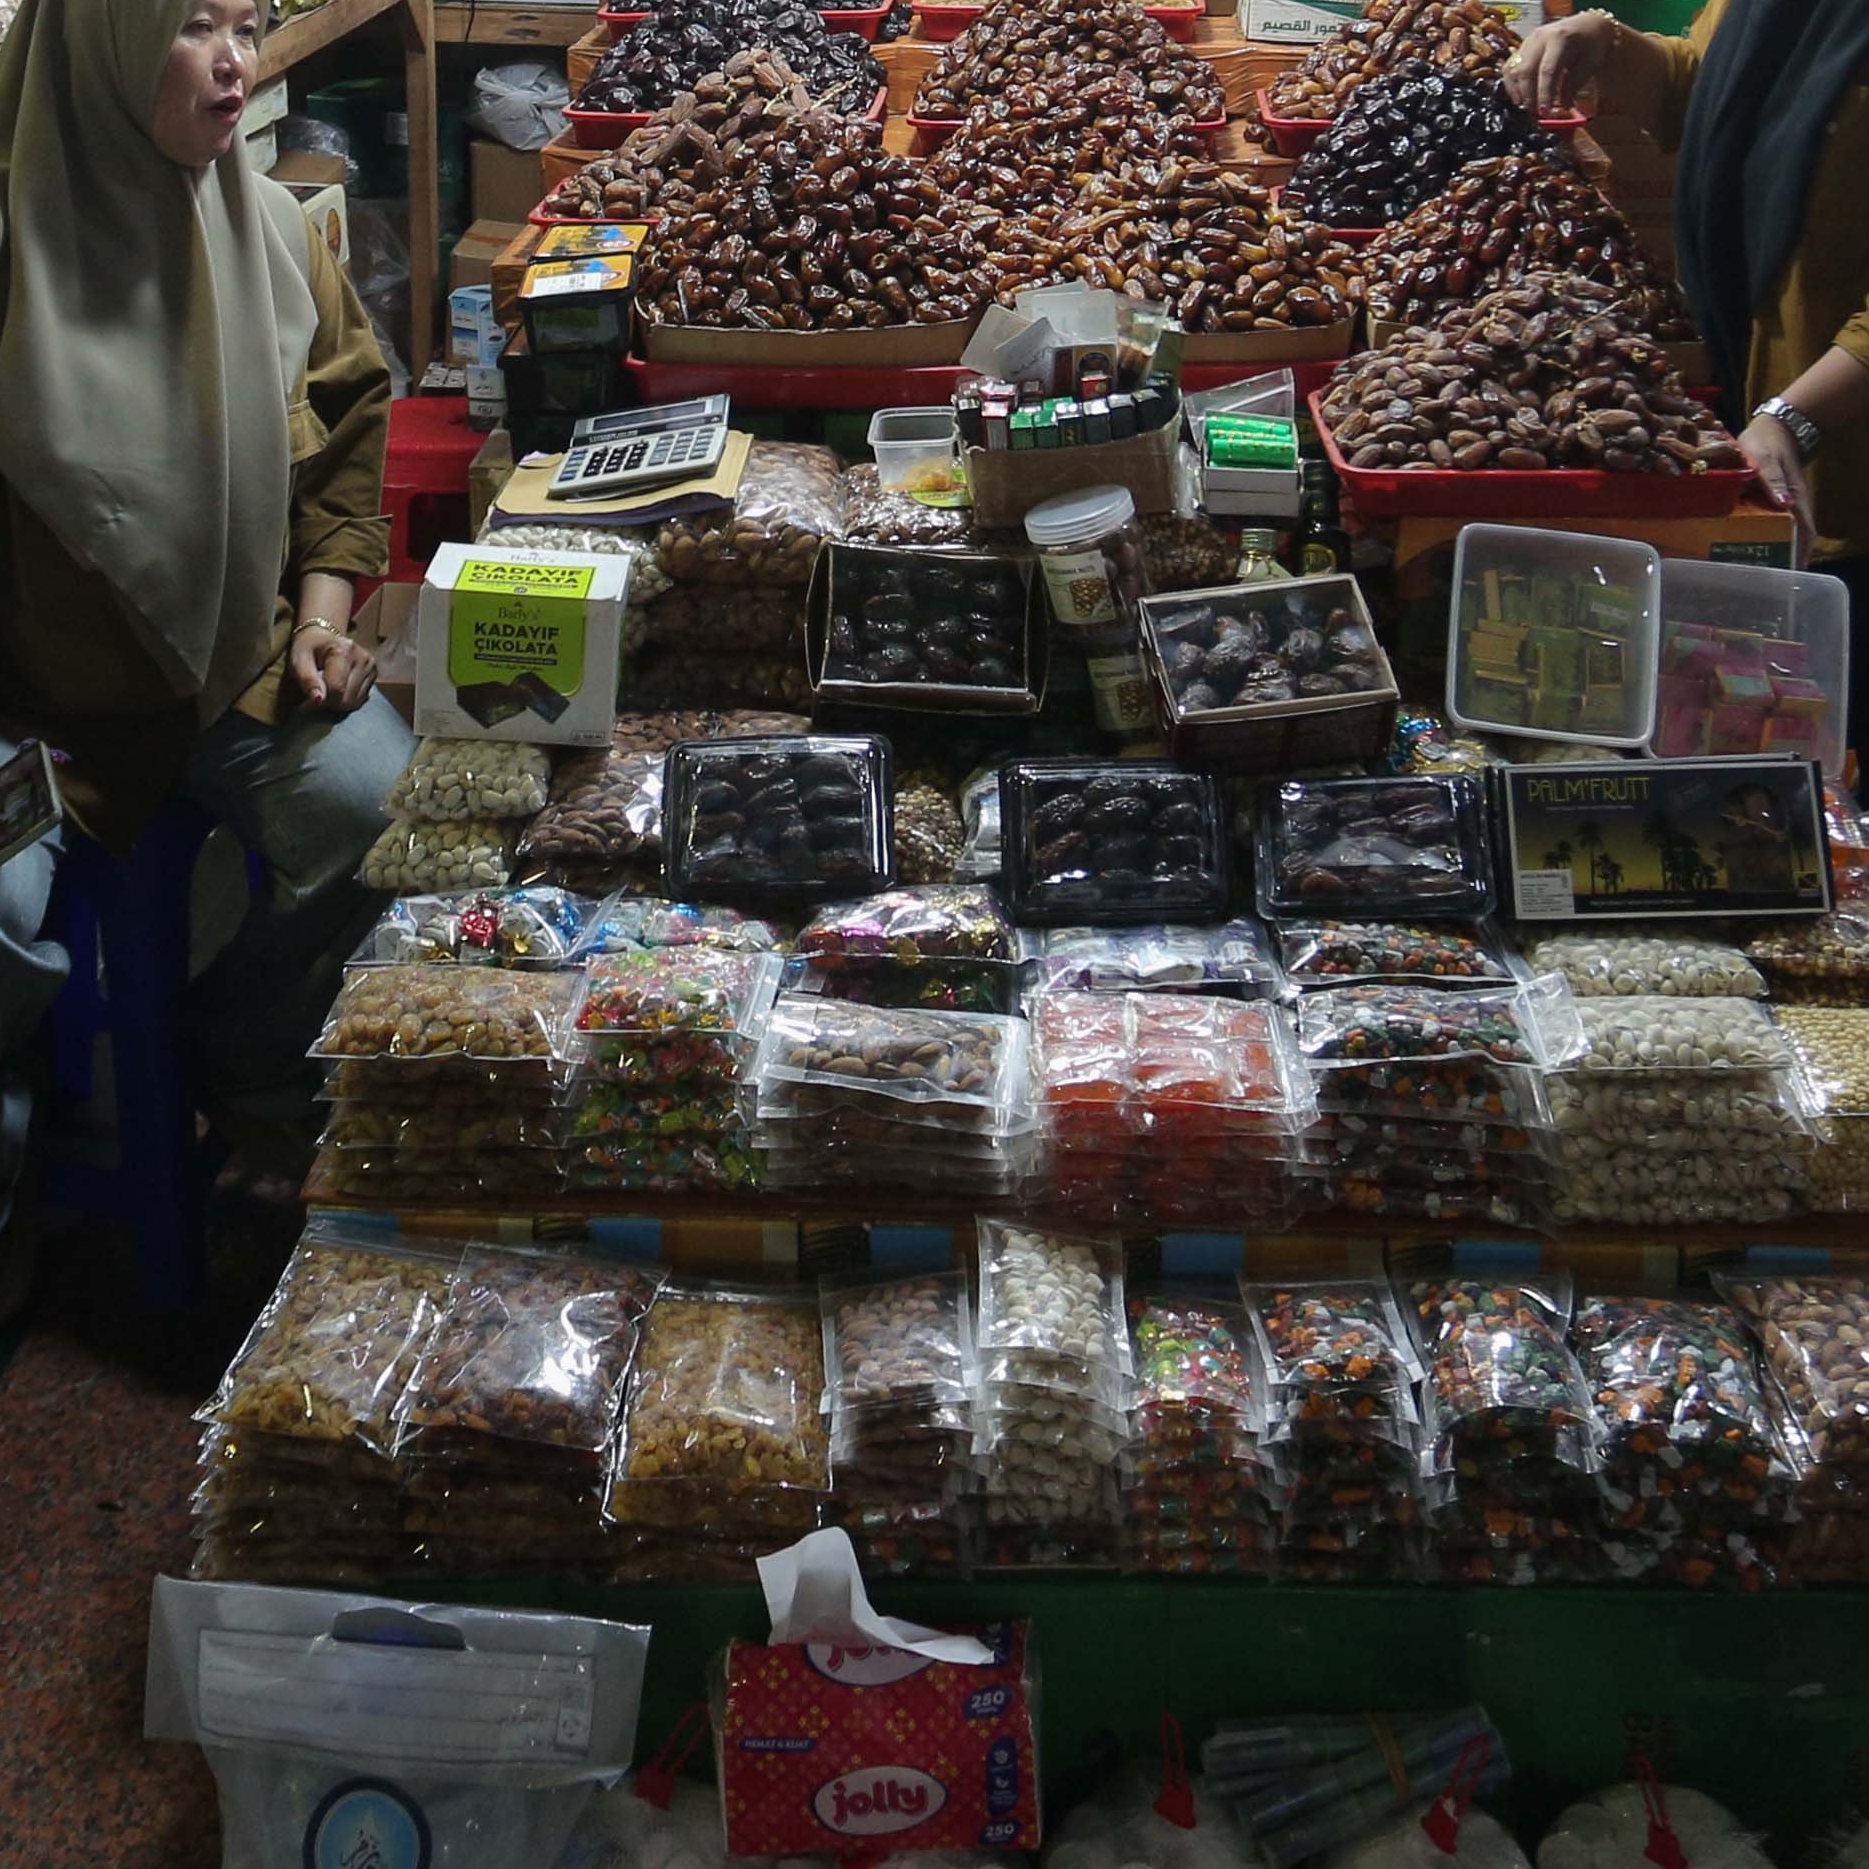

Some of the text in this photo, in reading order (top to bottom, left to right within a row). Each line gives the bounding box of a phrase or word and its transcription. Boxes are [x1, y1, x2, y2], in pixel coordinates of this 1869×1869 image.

[472, 564, 584, 577] KADAYIF
[473, 621, 560, 641] KADAYIF
[473, 637, 558, 657] ÇIKOLATA
[969, 1691, 1008, 1709] 250
[831, 1781, 929, 1835] jolly
[982, 1823, 1018, 1843] 250
